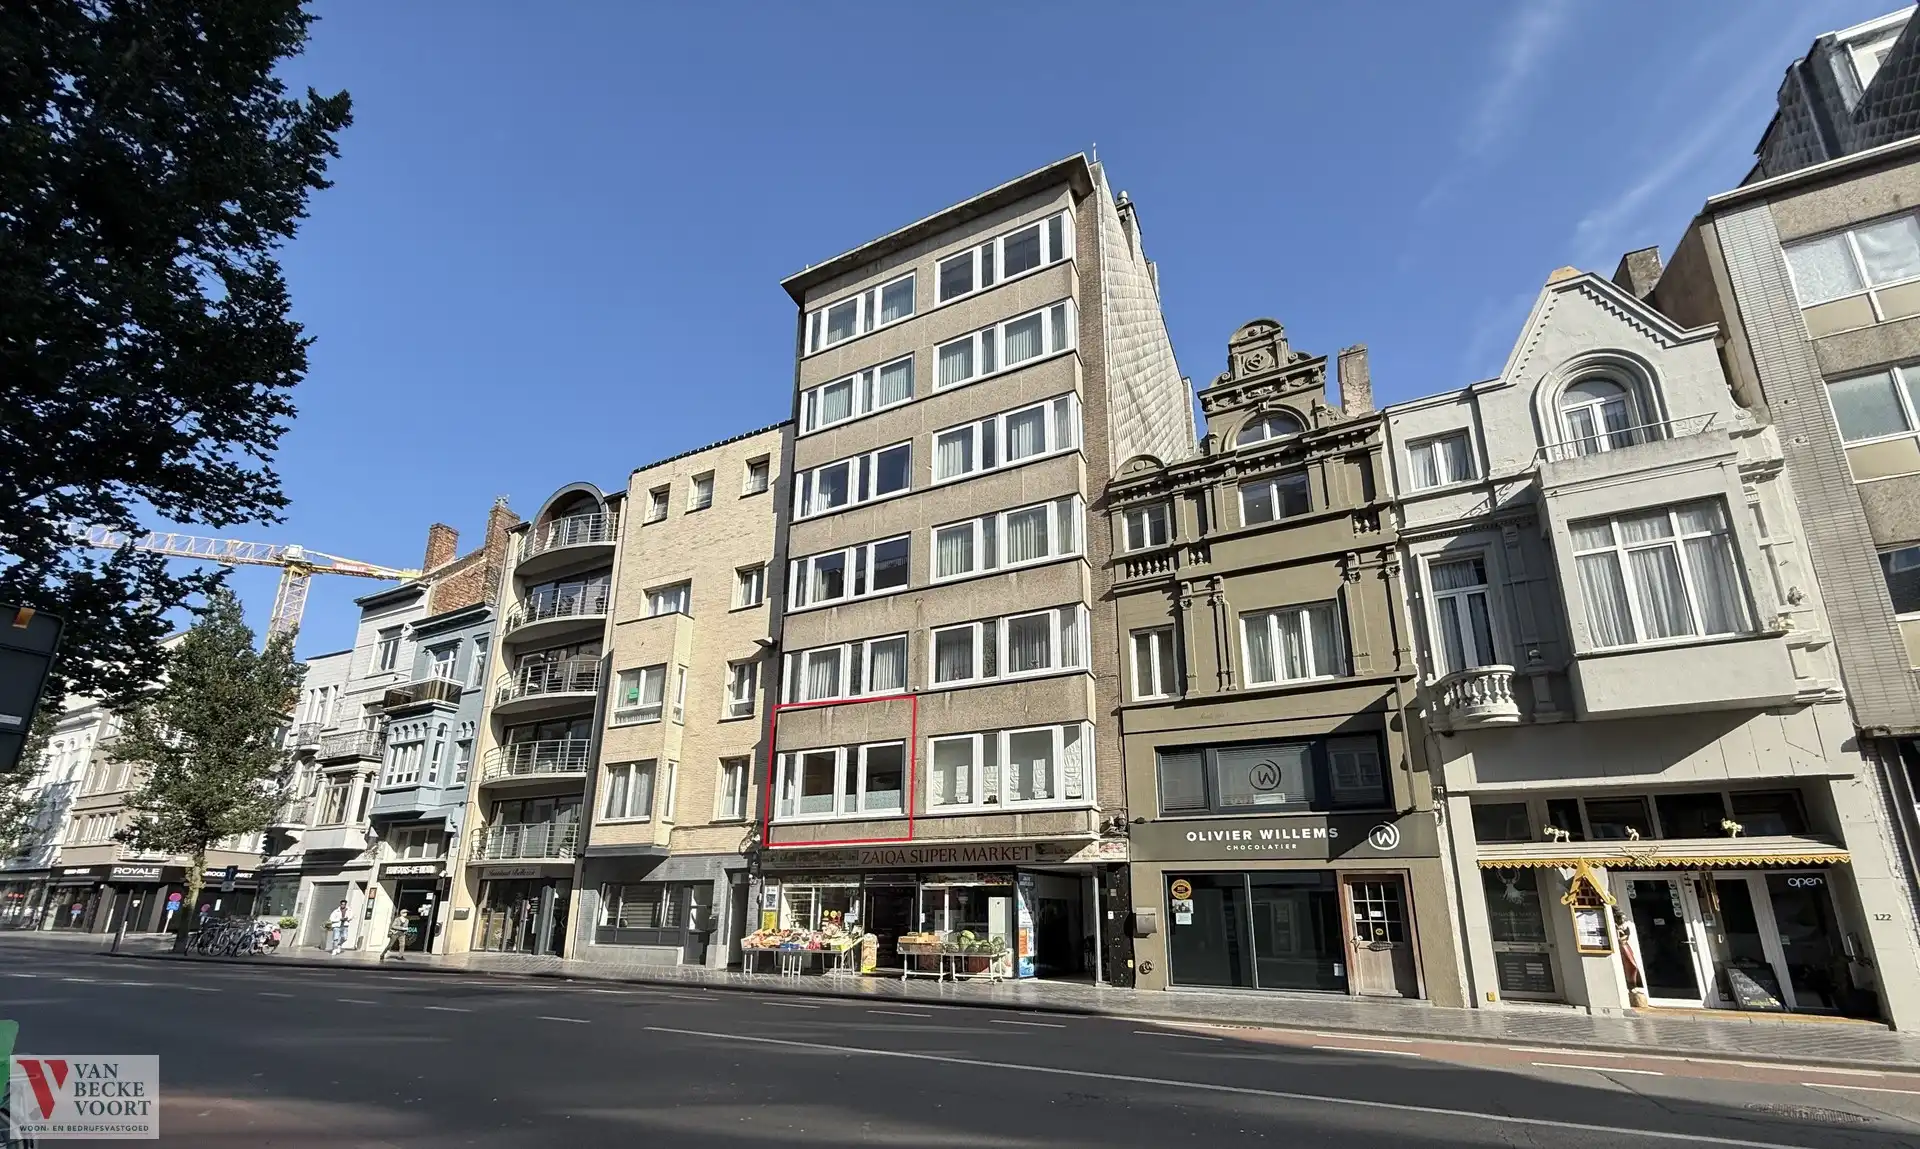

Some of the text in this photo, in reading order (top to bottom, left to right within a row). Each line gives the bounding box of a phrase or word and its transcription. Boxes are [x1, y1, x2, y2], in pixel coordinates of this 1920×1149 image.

[1186, 828, 1339, 842] OLIVIER WILLEMS
[861, 850, 907, 865] ZAIQA
[911, 847, 957, 862] SUPER
[962, 845, 1032, 861] MARKET
[113, 867, 161, 875] ROYALE
[1788, 877, 1823, 887] open
[1873, 913, 1892, 921] 122
